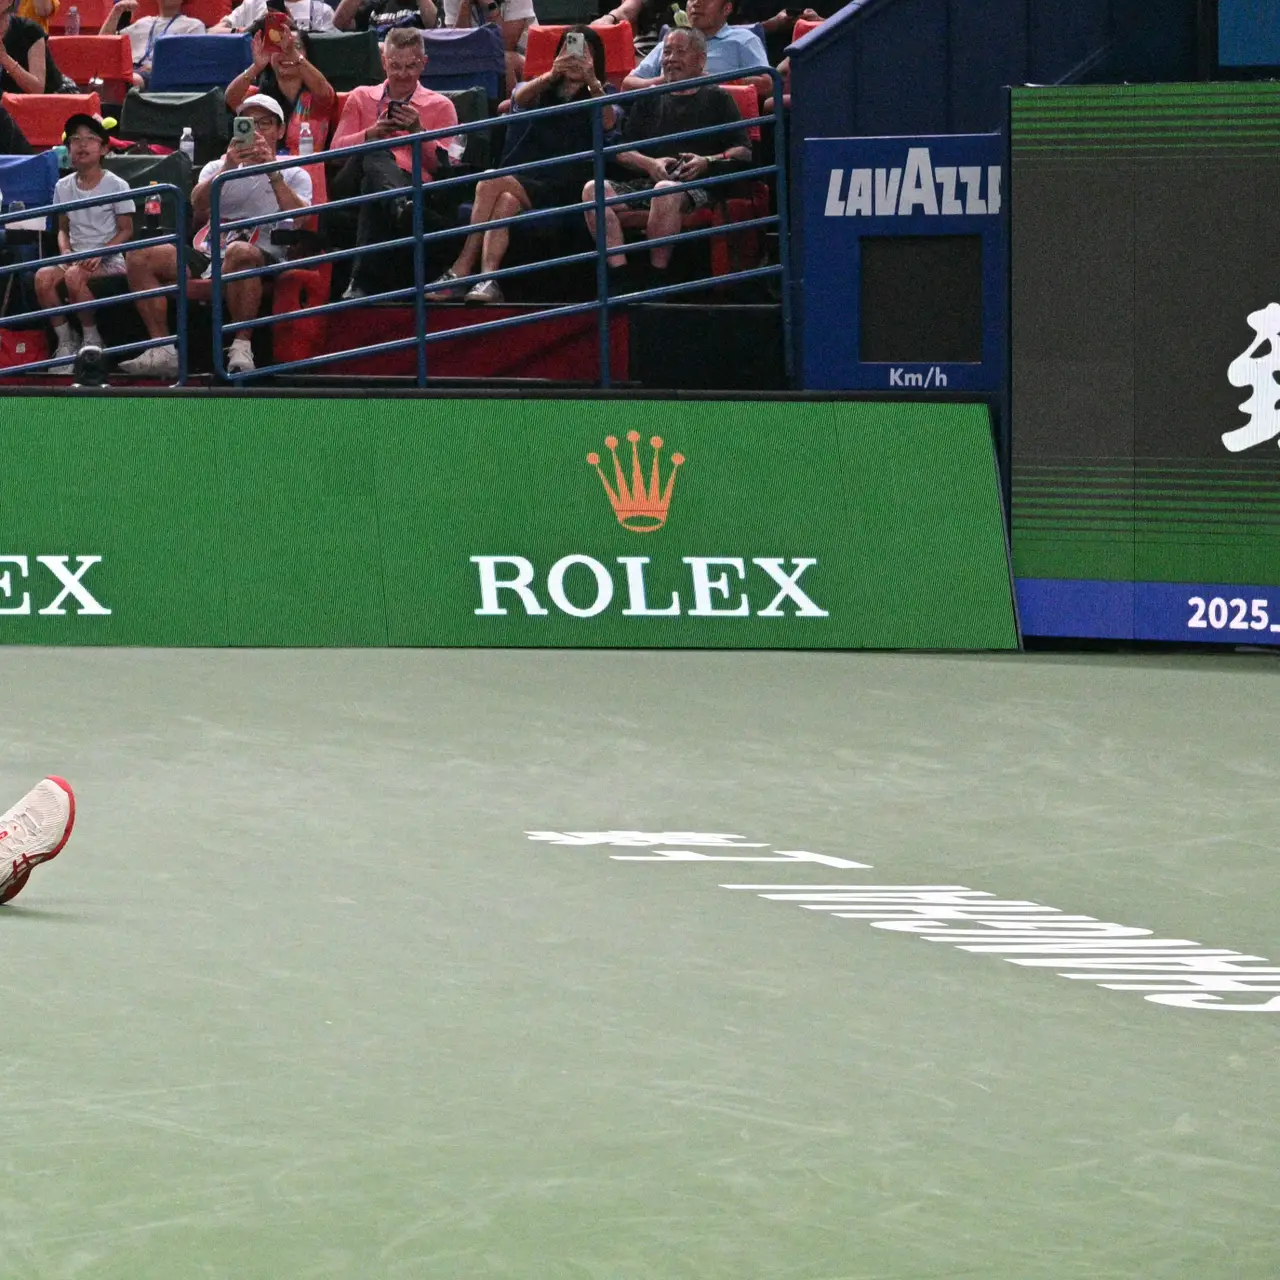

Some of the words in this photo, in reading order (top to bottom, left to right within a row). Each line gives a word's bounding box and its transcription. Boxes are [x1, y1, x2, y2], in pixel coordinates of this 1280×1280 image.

[889, 366, 947, 389] Km/h
[470, 555, 828, 617] ROLEX
[1188, 597, 1280, 632] 2025
